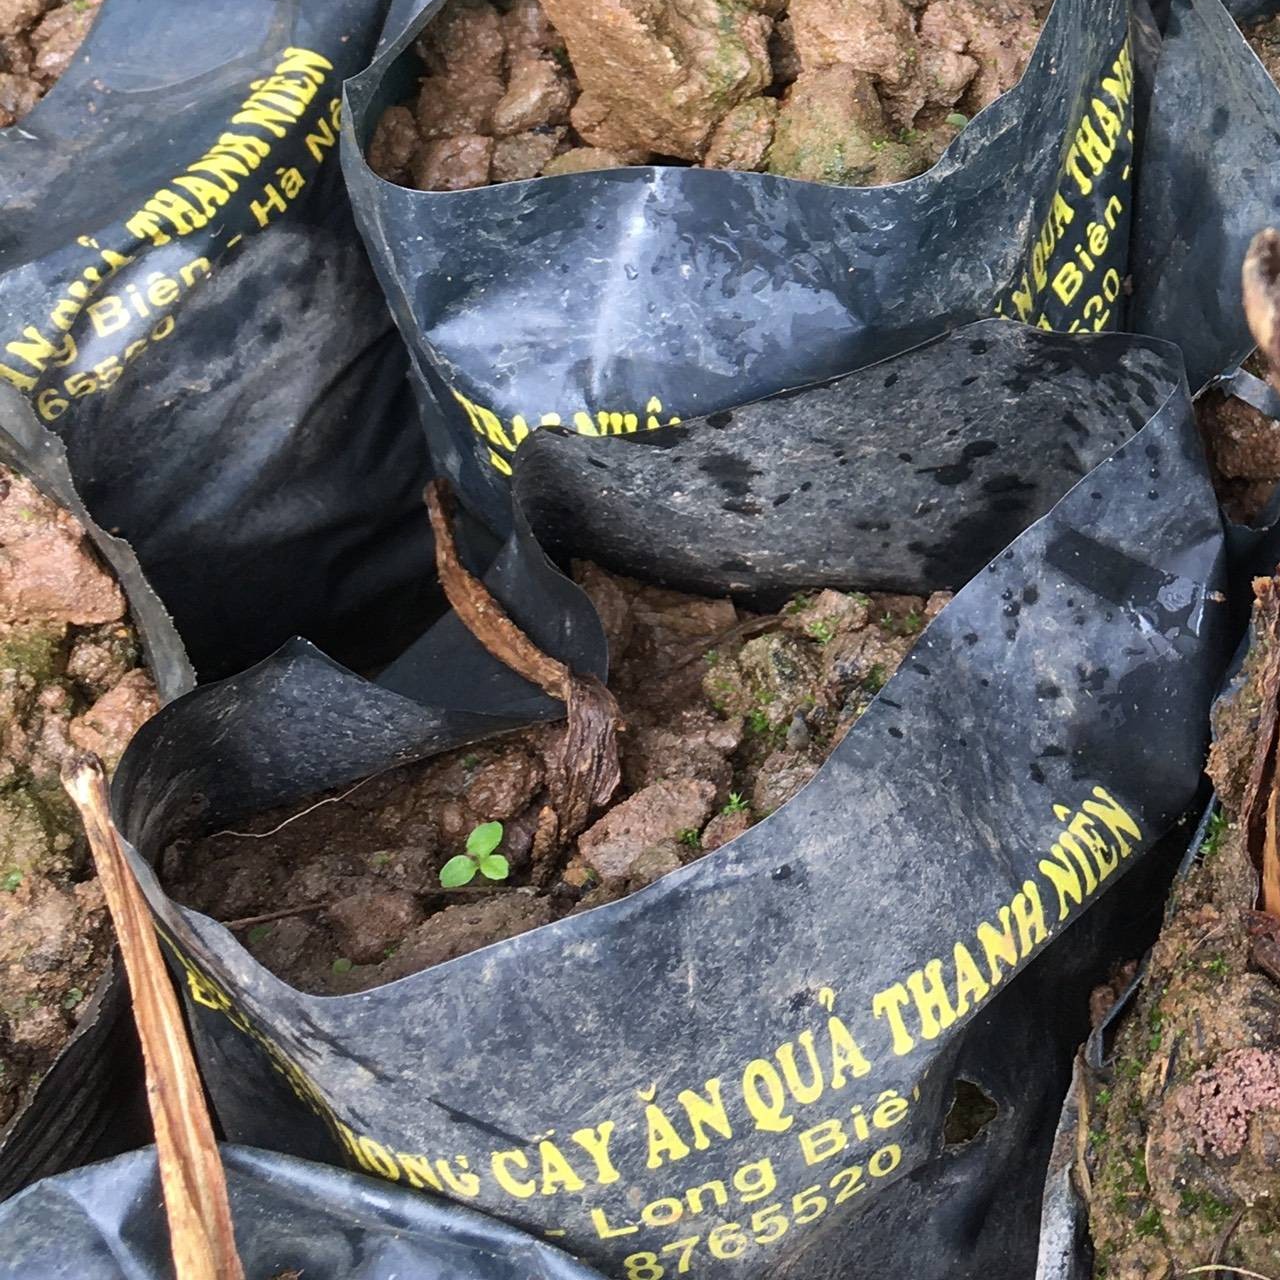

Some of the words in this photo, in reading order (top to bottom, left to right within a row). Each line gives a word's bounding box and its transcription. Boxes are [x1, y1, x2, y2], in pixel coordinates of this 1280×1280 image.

[126, 133, 271, 247] THANH
[232, 47, 334, 138] NIÊN
[86, 256, 212, 338] Biên
[249, 167, 306, 227] Hà
[1051, 195, 1123, 307] Biên
[636, 1083, 732, 1169] ĂN
[742, 986, 872, 1133] QUẢ
[874, 879, 1051, 1057] THANH
[1039, 785, 1143, 922] NIÊN
[590, 1157, 777, 1241] Long
[622, 1143, 903, 1280] 8765520
